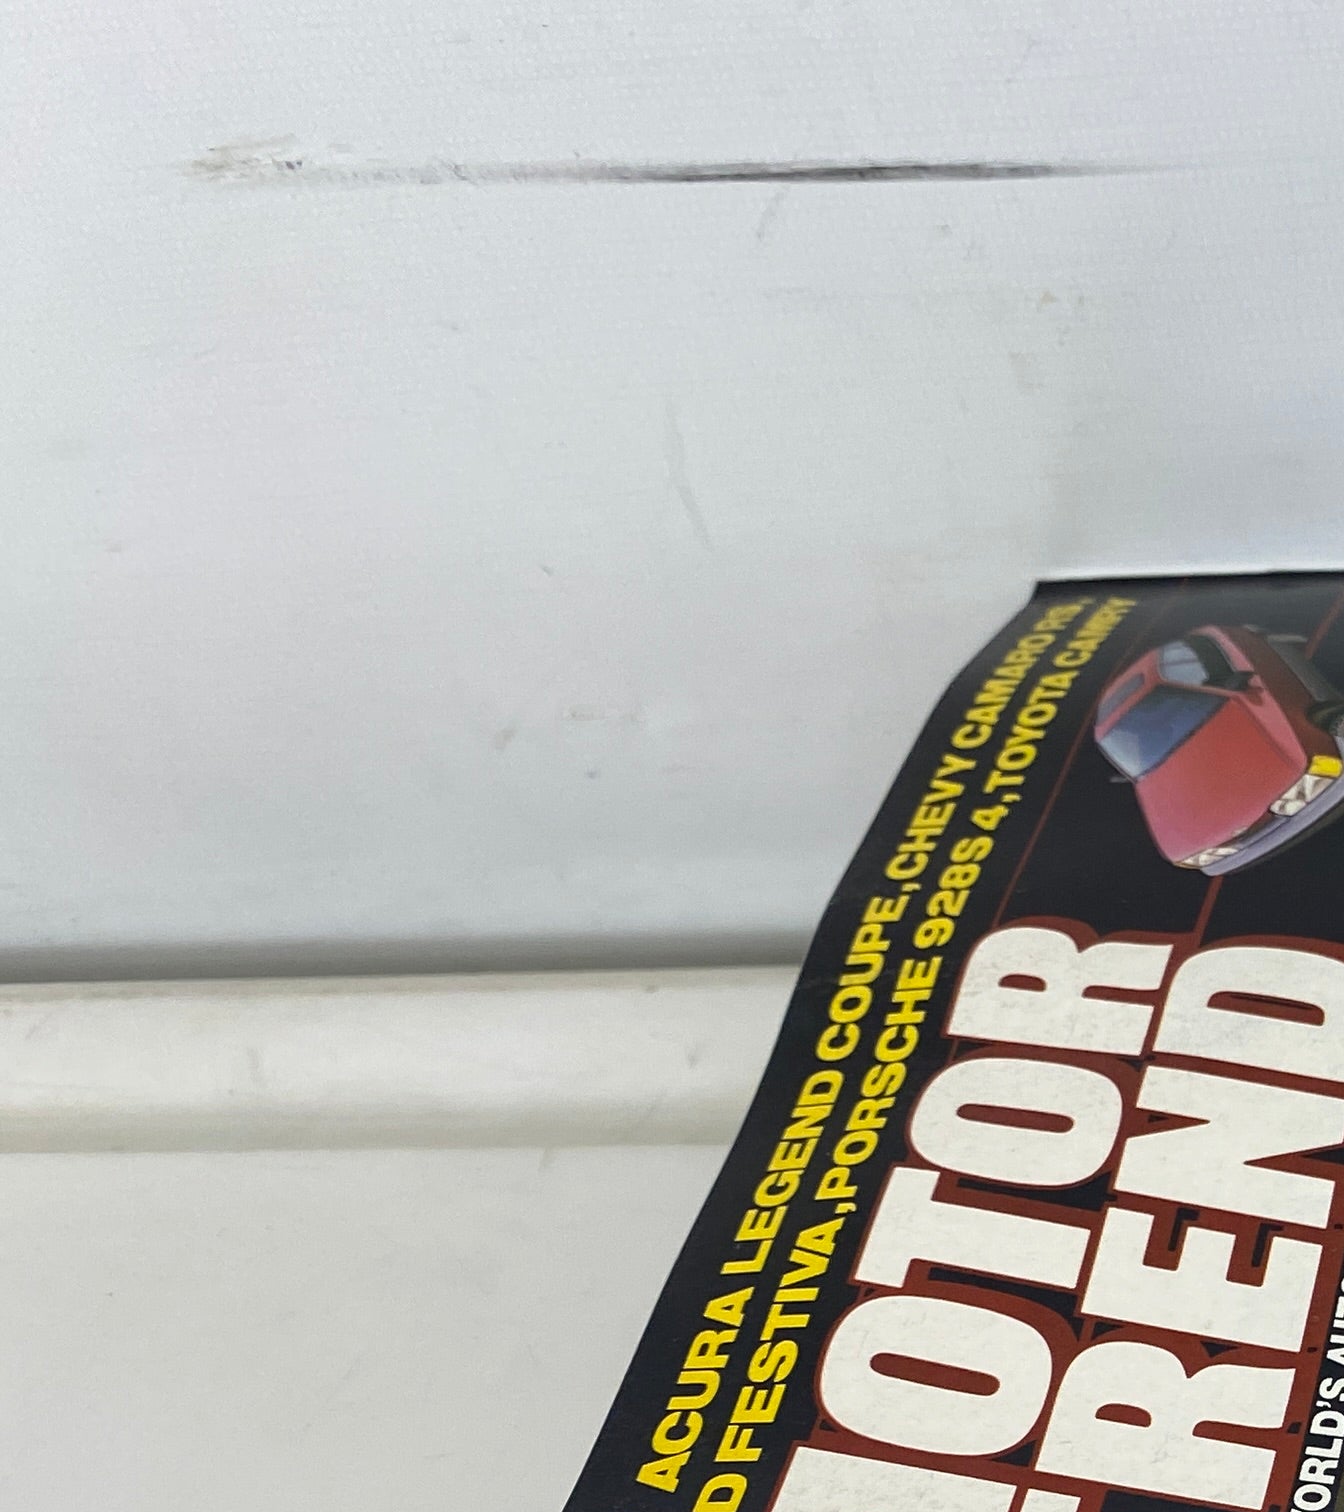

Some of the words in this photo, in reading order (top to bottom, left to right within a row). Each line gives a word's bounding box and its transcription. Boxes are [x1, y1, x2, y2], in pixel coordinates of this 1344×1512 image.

[635, 1286, 754, 1493] ACURA
[720, 1069, 845, 1275] LEGEND
[885, 754, 977, 880] CHEVY
[951, 633, 1056, 749] CAMARO
[814, 956, 944, 1201] PORSCHE
[983, 670, 1080, 794] TOYOTA
